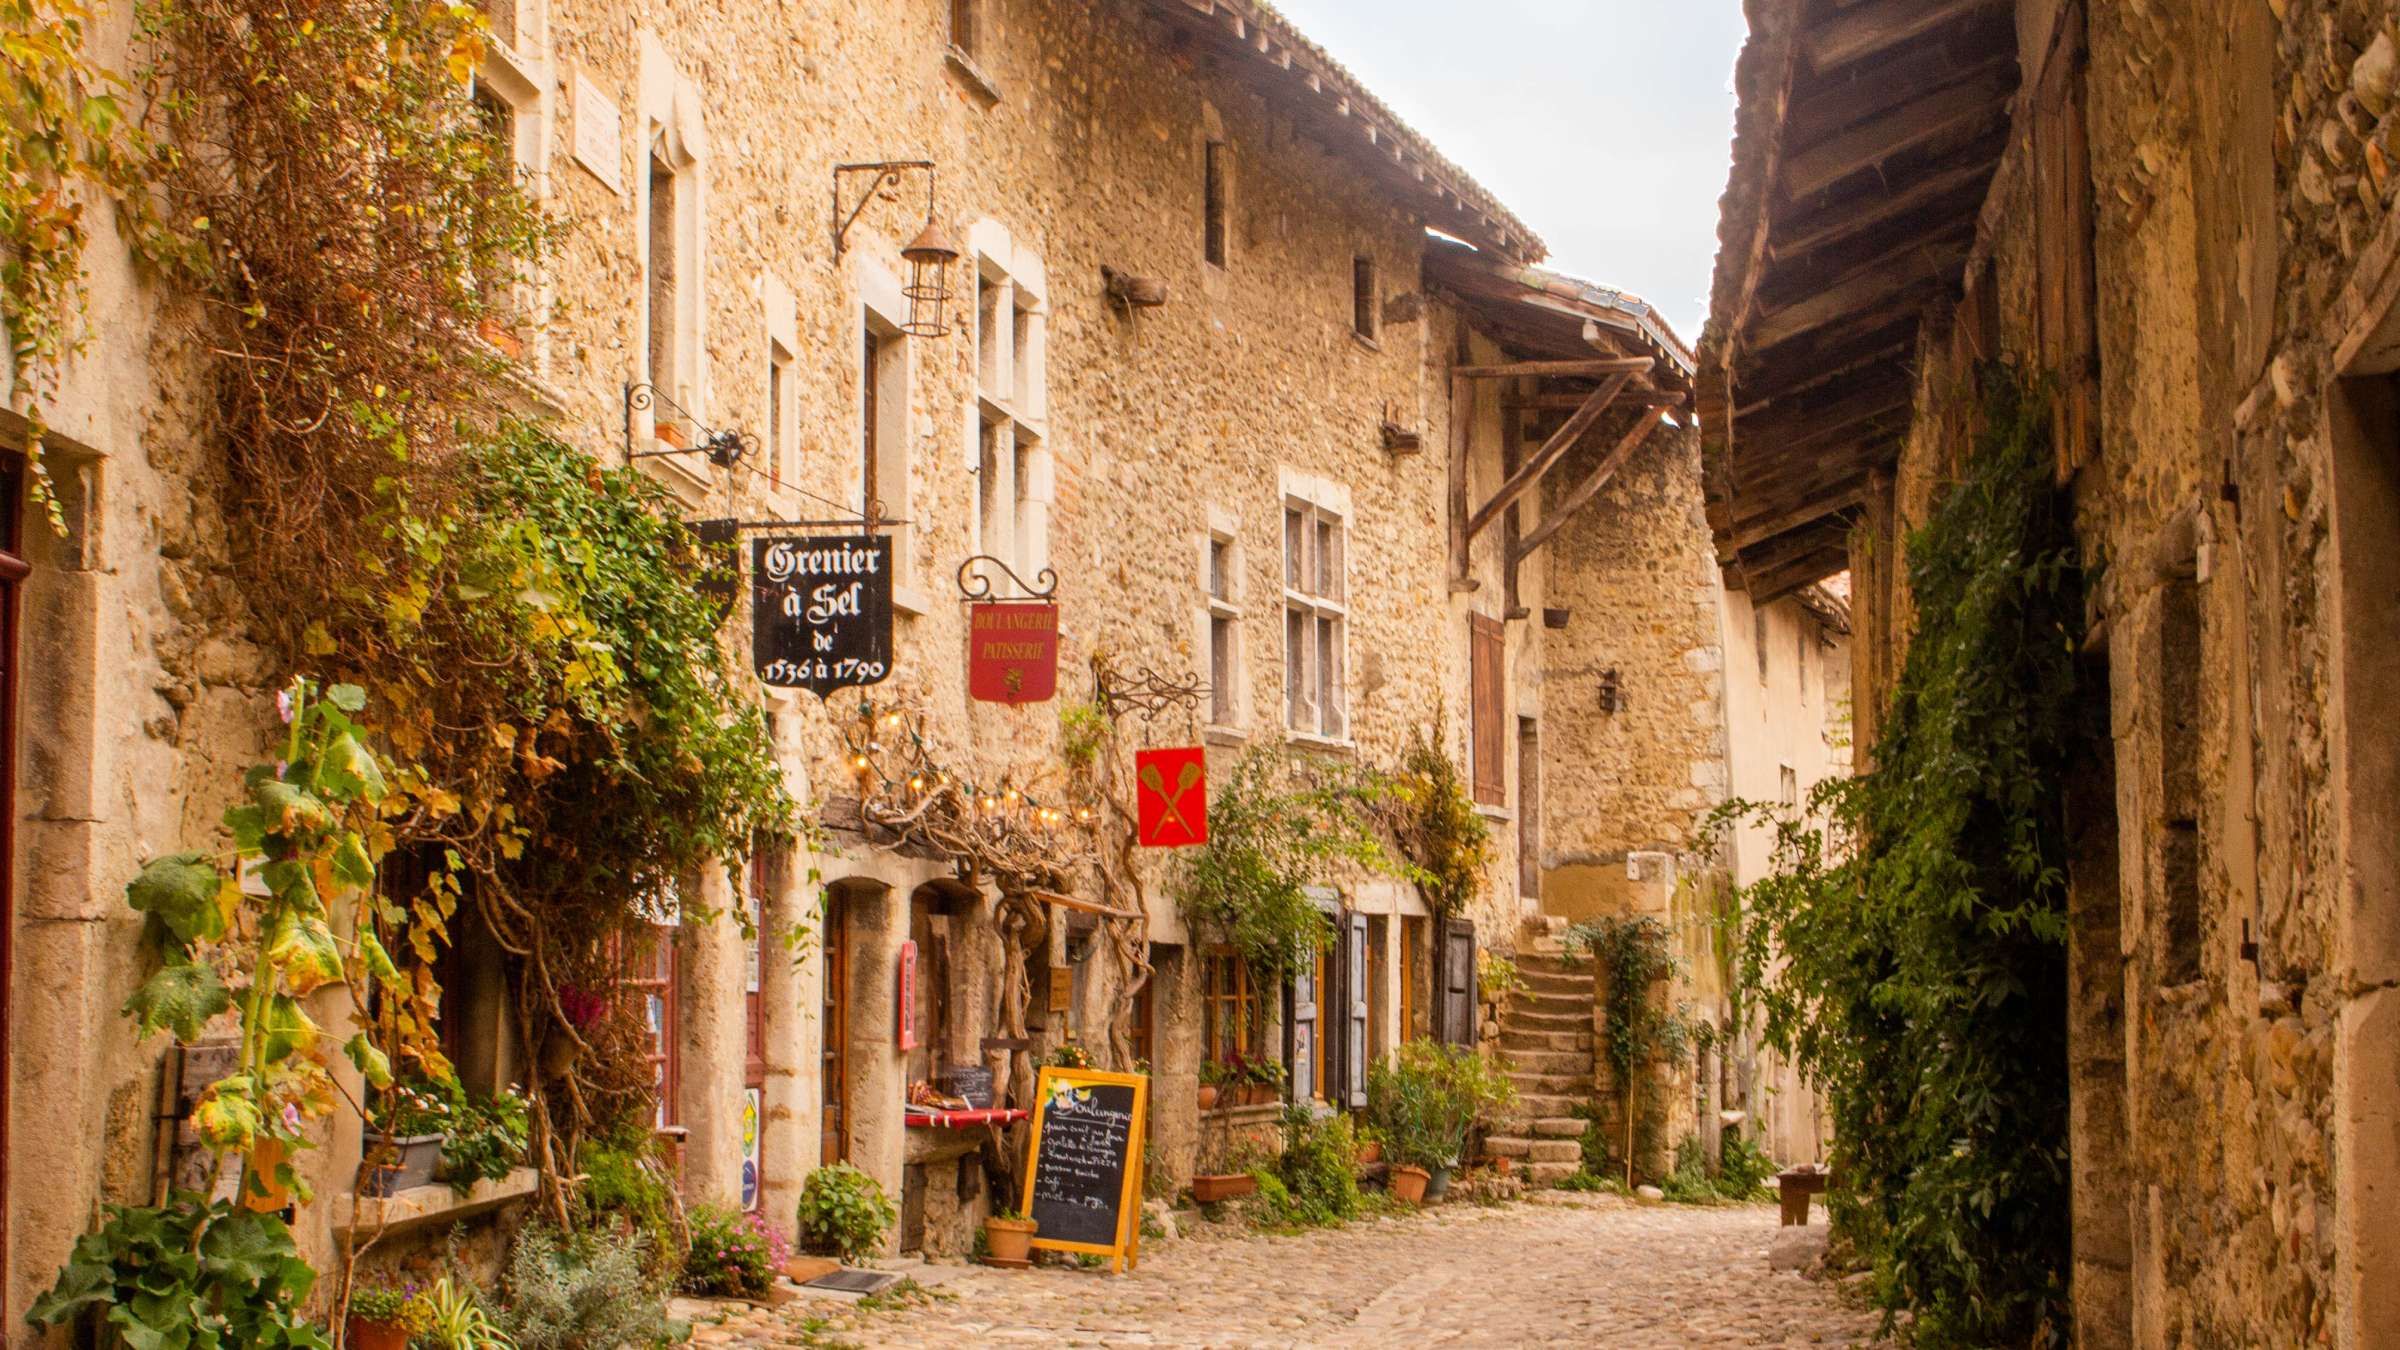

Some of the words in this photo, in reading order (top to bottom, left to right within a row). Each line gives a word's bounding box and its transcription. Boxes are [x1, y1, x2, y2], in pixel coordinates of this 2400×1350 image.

[765, 541, 881, 582] Grenier
[783, 584, 802, 617] à
[807, 581, 864, 624] Sel
[974, 612, 1053, 630] BOULANGERIE
[813, 629, 833, 652] de
[983, 642, 1044, 660] PATISSERIE
[764, 658, 811, 685] 1536
[815, 657, 828, 679] à
[833, 658, 885, 683] 1790
